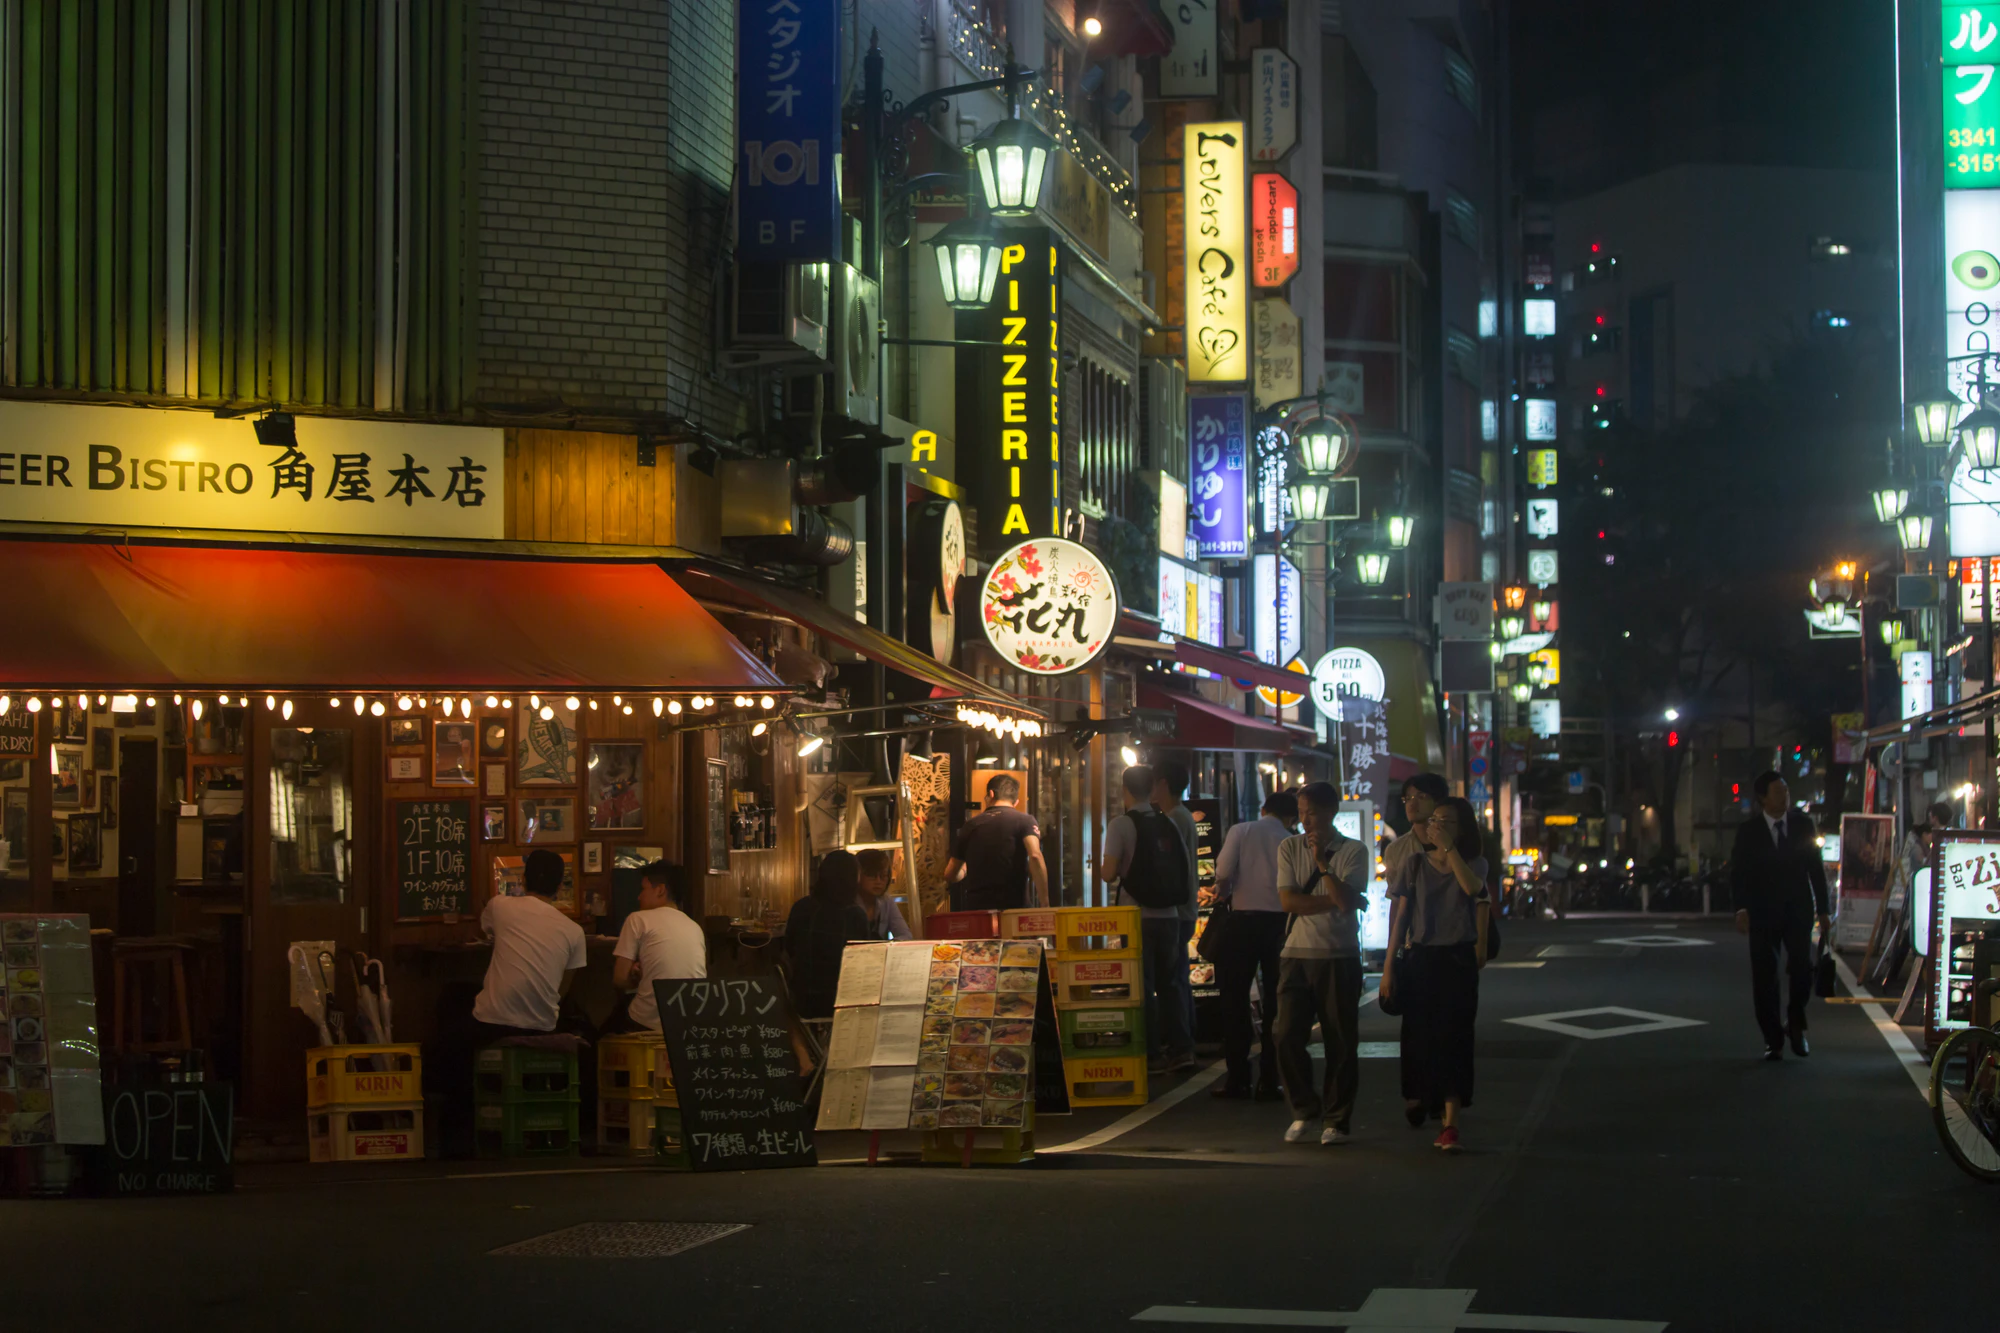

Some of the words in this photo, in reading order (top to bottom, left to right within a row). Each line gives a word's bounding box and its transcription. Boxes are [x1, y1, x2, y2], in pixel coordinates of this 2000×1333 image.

[1949, 127, 1996, 147] 3341
[745, 139, 819, 187] 101
[1198, 247, 1234, 317] Café
[1264, 267, 1280, 281] 3F
[1001, 243, 1030, 535] PIZZERIA
[1050, 246, 1060, 536] PIZZERIA
[267, 446, 488, 508] 角屋本店
[1196, 415, 1224, 527] かりゆし
[1047, 546, 1060, 599] 炭火焼鳥
[1060, 584, 1092, 608] 新宿
[998, 582, 1090, 645] 花丸
[1018, 640, 1073, 648] HANAMARU
[1332, 658, 1362, 669] PIZZA
[0, 712, 30, 729] AHI
[1374, 703, 1390, 757] 北海道
[10, 736, 34, 752] DRY
[404, 817, 431, 845] 2F
[407, 850, 431, 875] 1F
[1949, 862, 1966, 890] Bar
[1077, 920, 1118, 933] KIRIN
[667, 979, 777, 1017] イタリアン
[355, 1076, 403, 1092] KIRIN
[1084, 1067, 1125, 1079] KIRIN
[110, 1083, 234, 1164] OPEN
[118, 1172, 147, 1192] NO
[156, 1172, 217, 1192] CHARGE
